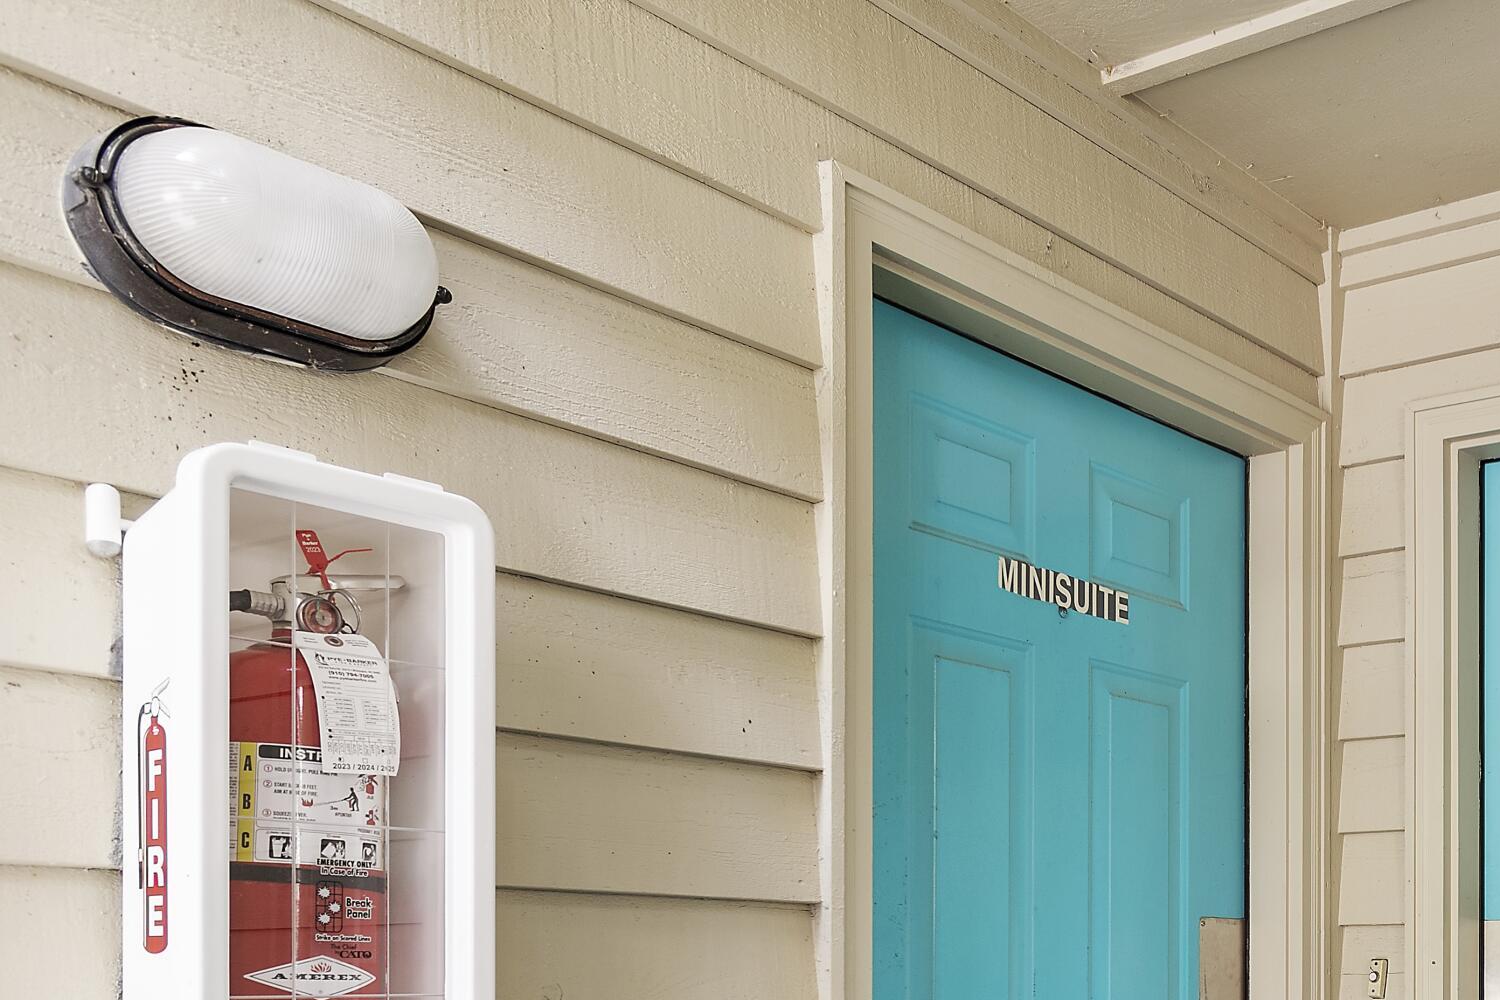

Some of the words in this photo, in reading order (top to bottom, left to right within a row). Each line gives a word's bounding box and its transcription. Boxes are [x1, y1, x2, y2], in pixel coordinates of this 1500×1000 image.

[997, 556, 1129, 625] MINISUITE
[243, 754, 252, 771] A
[242, 793, 251, 810] B
[147, 749, 164, 937] FIRE
[241, 831, 250, 849] C
[317, 858, 355, 868] EMERGENCY
[357, 860, 373, 869] ONLY
[322, 867, 328, 875] In
[330, 867, 345, 876] Case
[347, 868, 354, 876] of
[356, 868, 368, 877] Fire
[346, 897, 372, 908] Break
[346, 909, 371, 919] Panel
[272, 973, 362, 981] AMEREX
